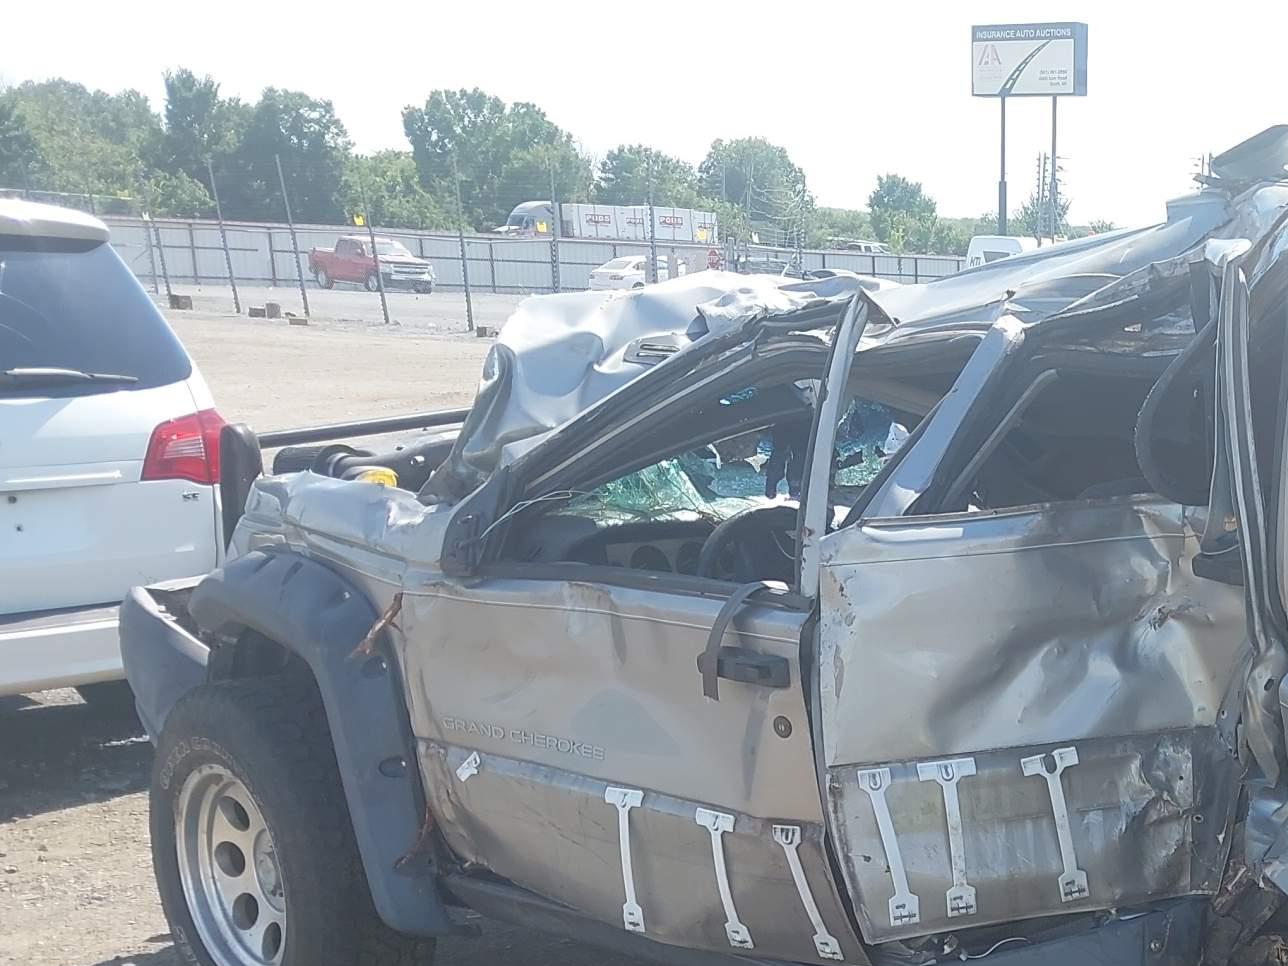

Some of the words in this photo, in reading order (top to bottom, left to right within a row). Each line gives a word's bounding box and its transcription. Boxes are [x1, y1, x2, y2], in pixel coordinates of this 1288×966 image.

[976, 30, 1015, 39] INSURANCE
[1016, 29, 1035, 38] AUTO
[1036, 28, 1071, 37] AUCTIONS
[442, 717, 505, 739] GRAND
[510, 730, 606, 761] CHEROKEE
